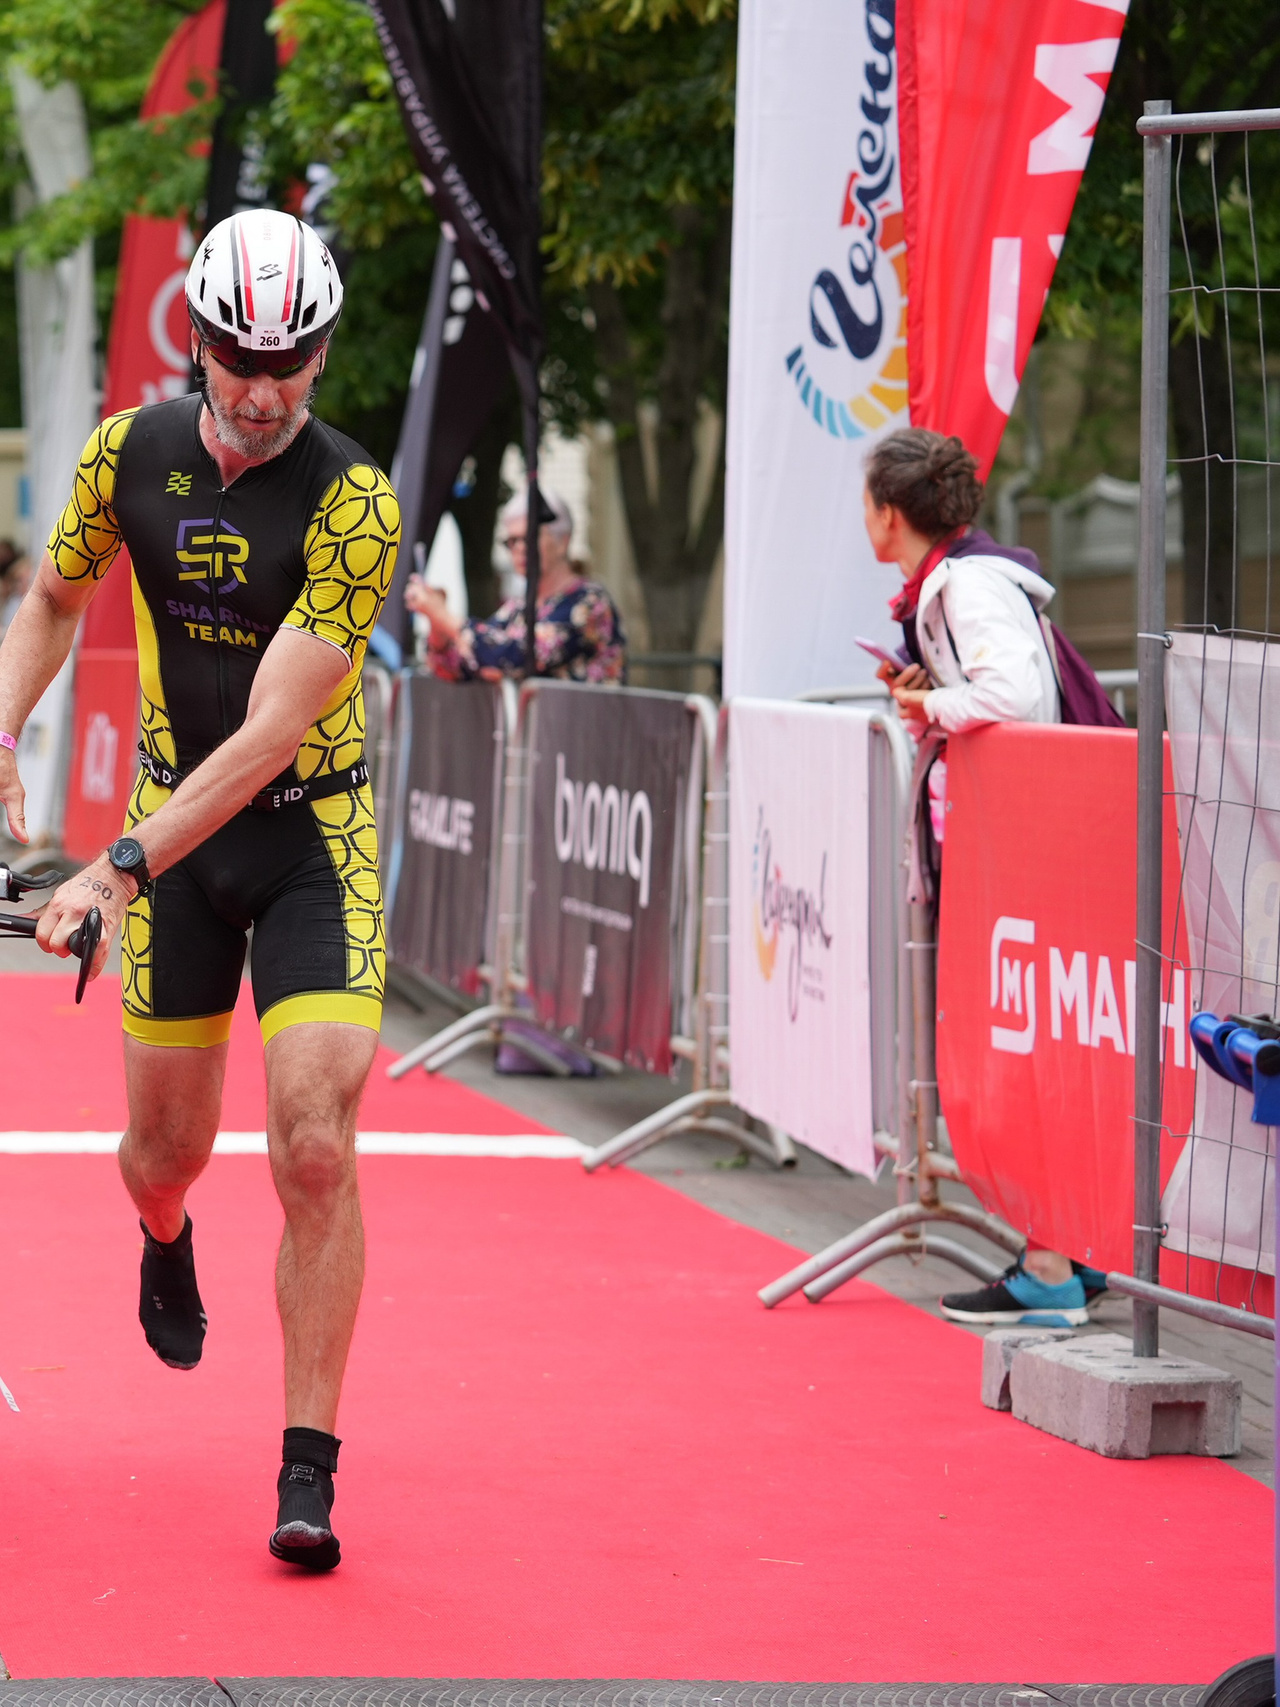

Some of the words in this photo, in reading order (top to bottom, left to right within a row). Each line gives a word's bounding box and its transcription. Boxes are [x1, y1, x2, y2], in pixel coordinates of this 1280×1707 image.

[259, 335, 281, 347] 260
[166, 599, 271, 633] SHARUN
[184, 621, 257, 648] TEAM
[554, 752, 654, 909] bioniq
[79, 876, 114, 901] 260
